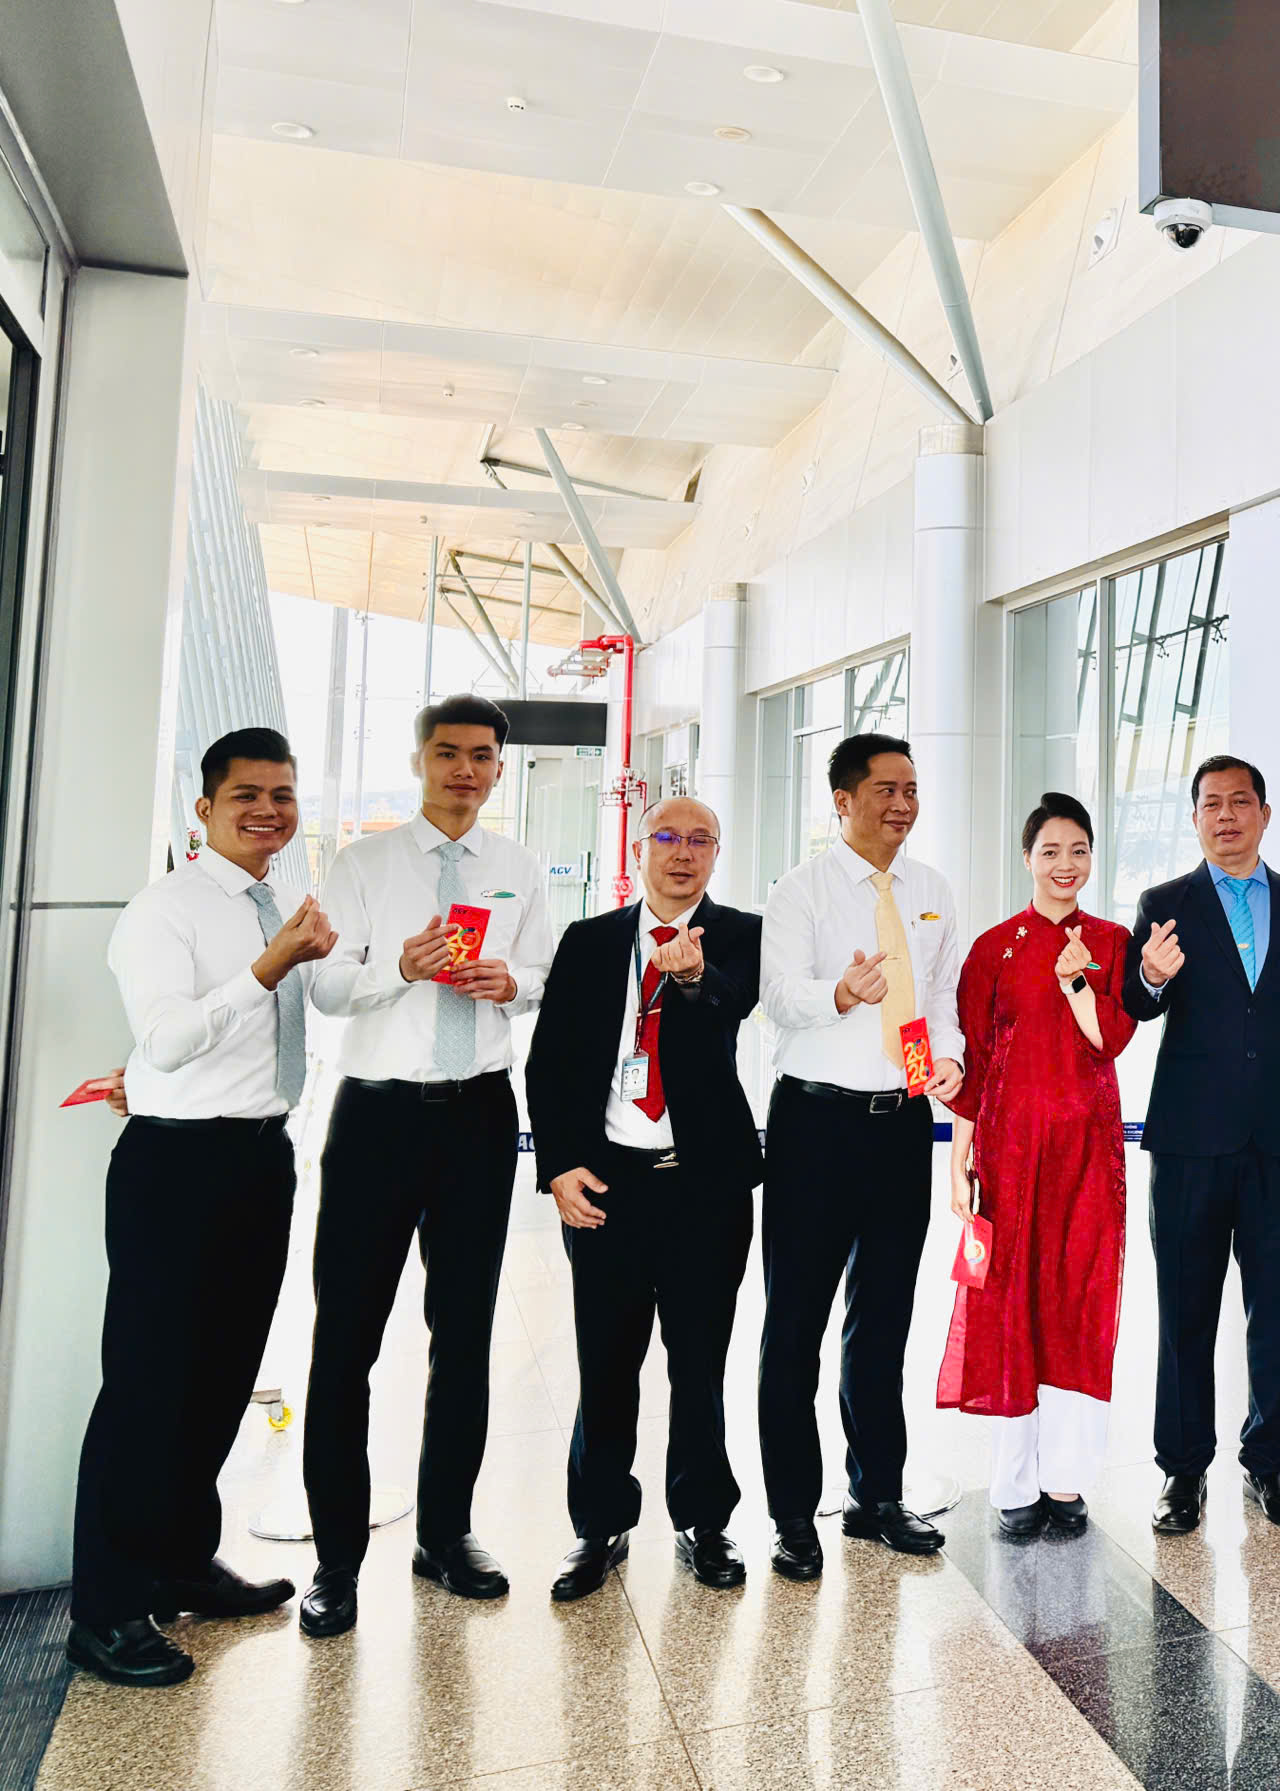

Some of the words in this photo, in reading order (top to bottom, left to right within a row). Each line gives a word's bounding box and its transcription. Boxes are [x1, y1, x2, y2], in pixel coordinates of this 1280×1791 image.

[550, 866, 573, 875] ACV
[904, 1038, 928, 1064] 20
[908, 1060, 930, 1086] 26
